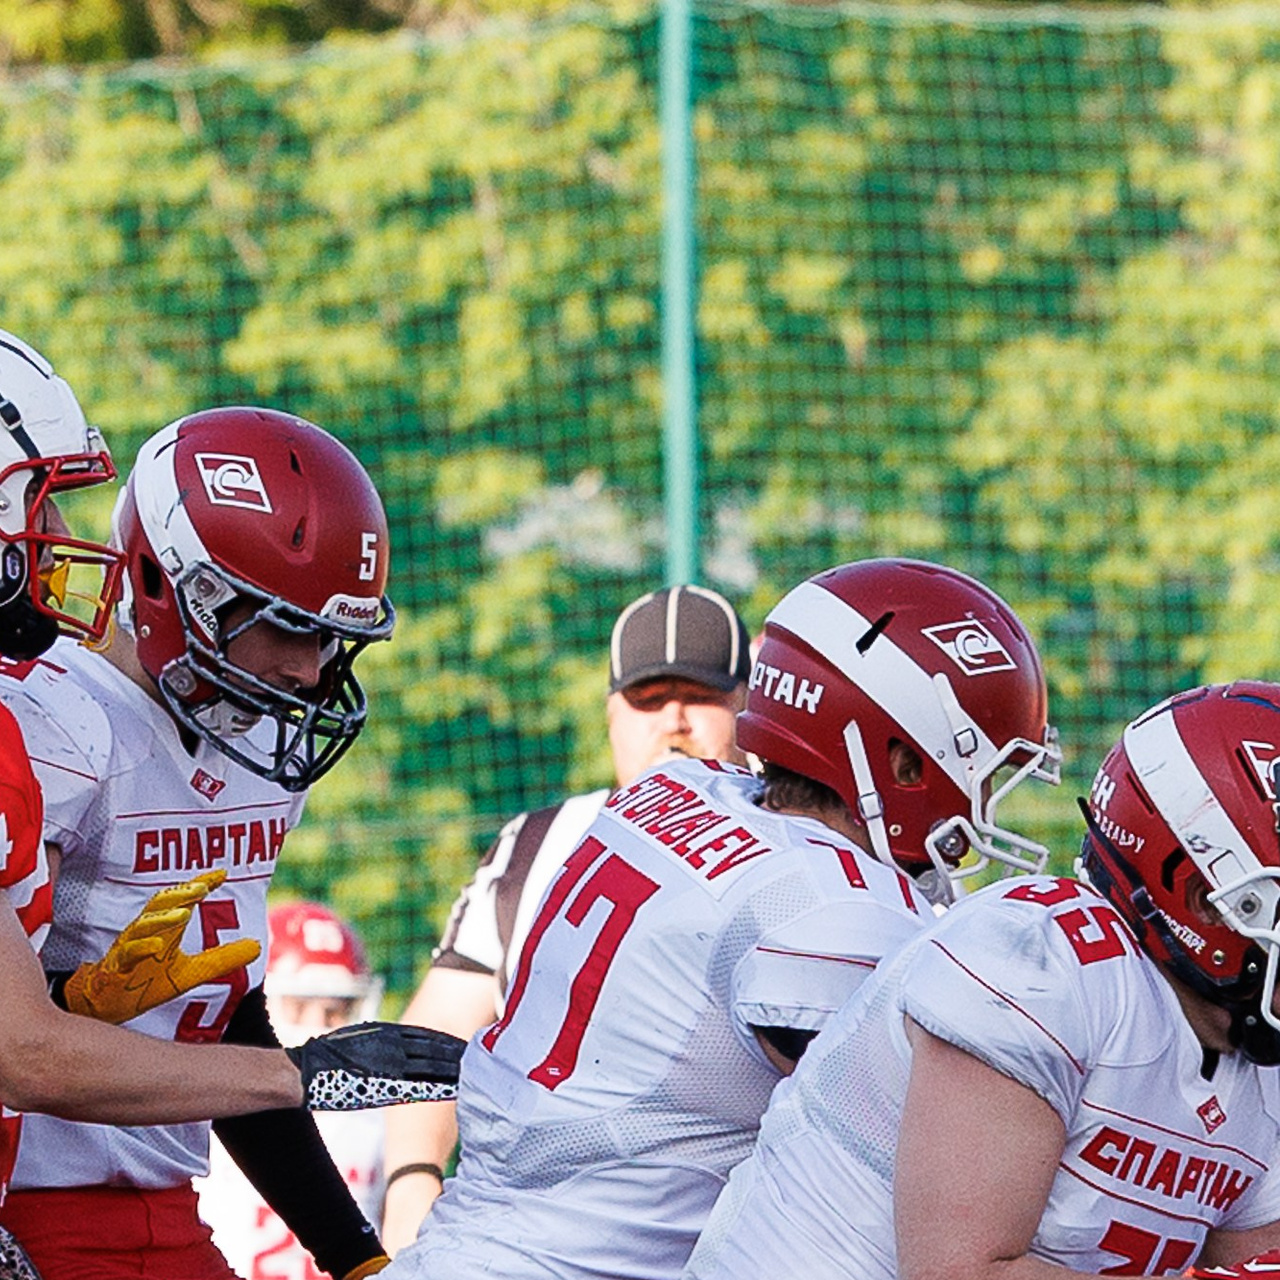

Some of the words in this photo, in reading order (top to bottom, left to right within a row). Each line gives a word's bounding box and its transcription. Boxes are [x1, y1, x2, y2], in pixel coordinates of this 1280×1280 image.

[358, 532, 378, 581] 5
[748, 662, 825, 716] РТАК
[482, 834, 661, 1092] 17
